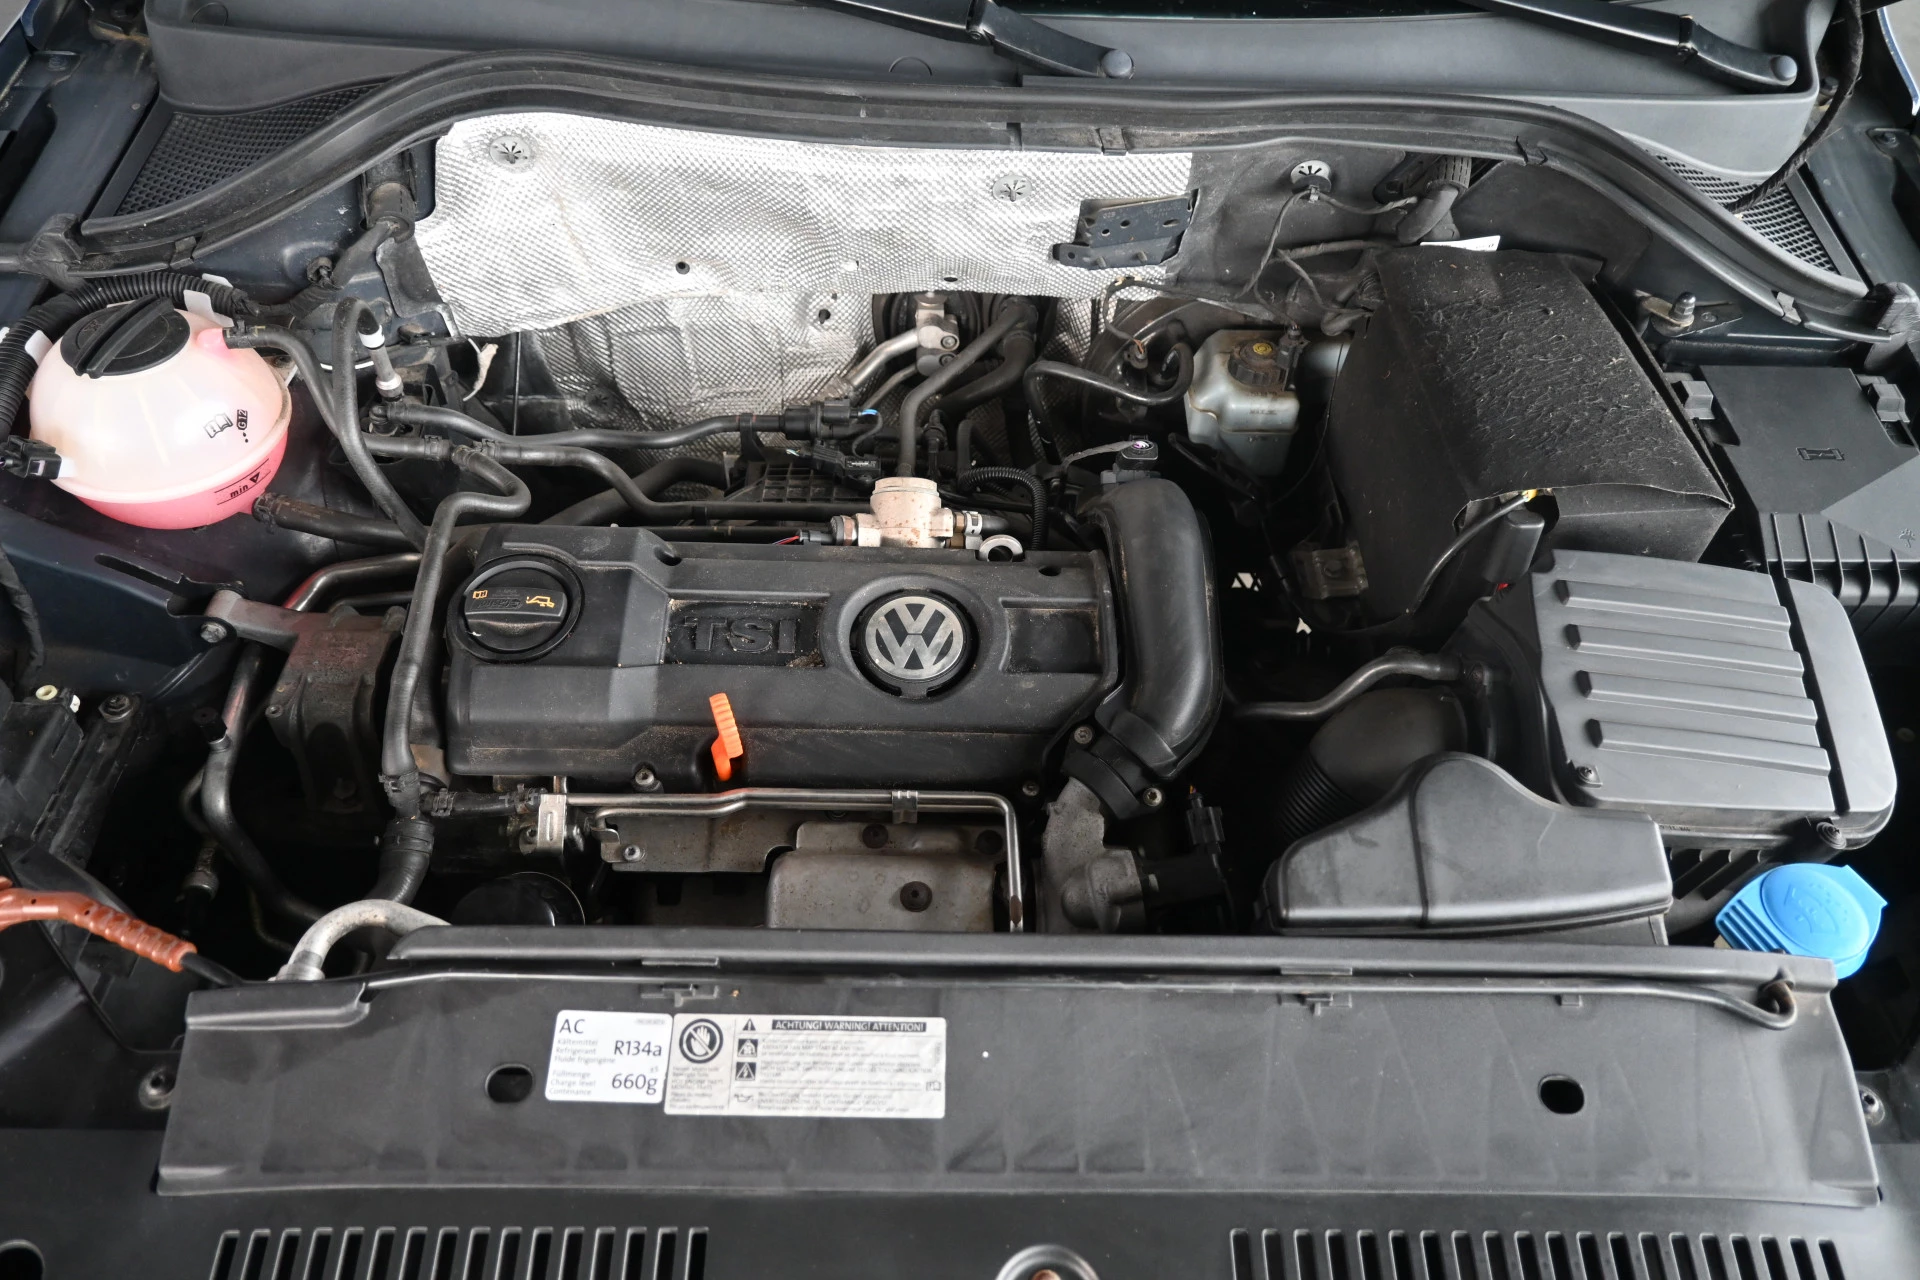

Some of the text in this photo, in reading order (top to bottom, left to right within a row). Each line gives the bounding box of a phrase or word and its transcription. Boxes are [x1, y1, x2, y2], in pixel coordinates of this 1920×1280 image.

[237, 409, 248, 430] G12
[230, 484, 249, 499] min
[684, 616, 799, 654] TSI
[559, 1018, 585, 1034] AC
[775, 1020, 924, 1032] ACHTUNG! WARNING! ATTENTION!
[556, 1047, 596, 1055] Refrigerant
[614, 1040, 662, 1056] R134a
[551, 1079, 576, 1088] Charge
[612, 1073, 658, 1096] 660g
[549, 1088, 591, 1096] Contenance
